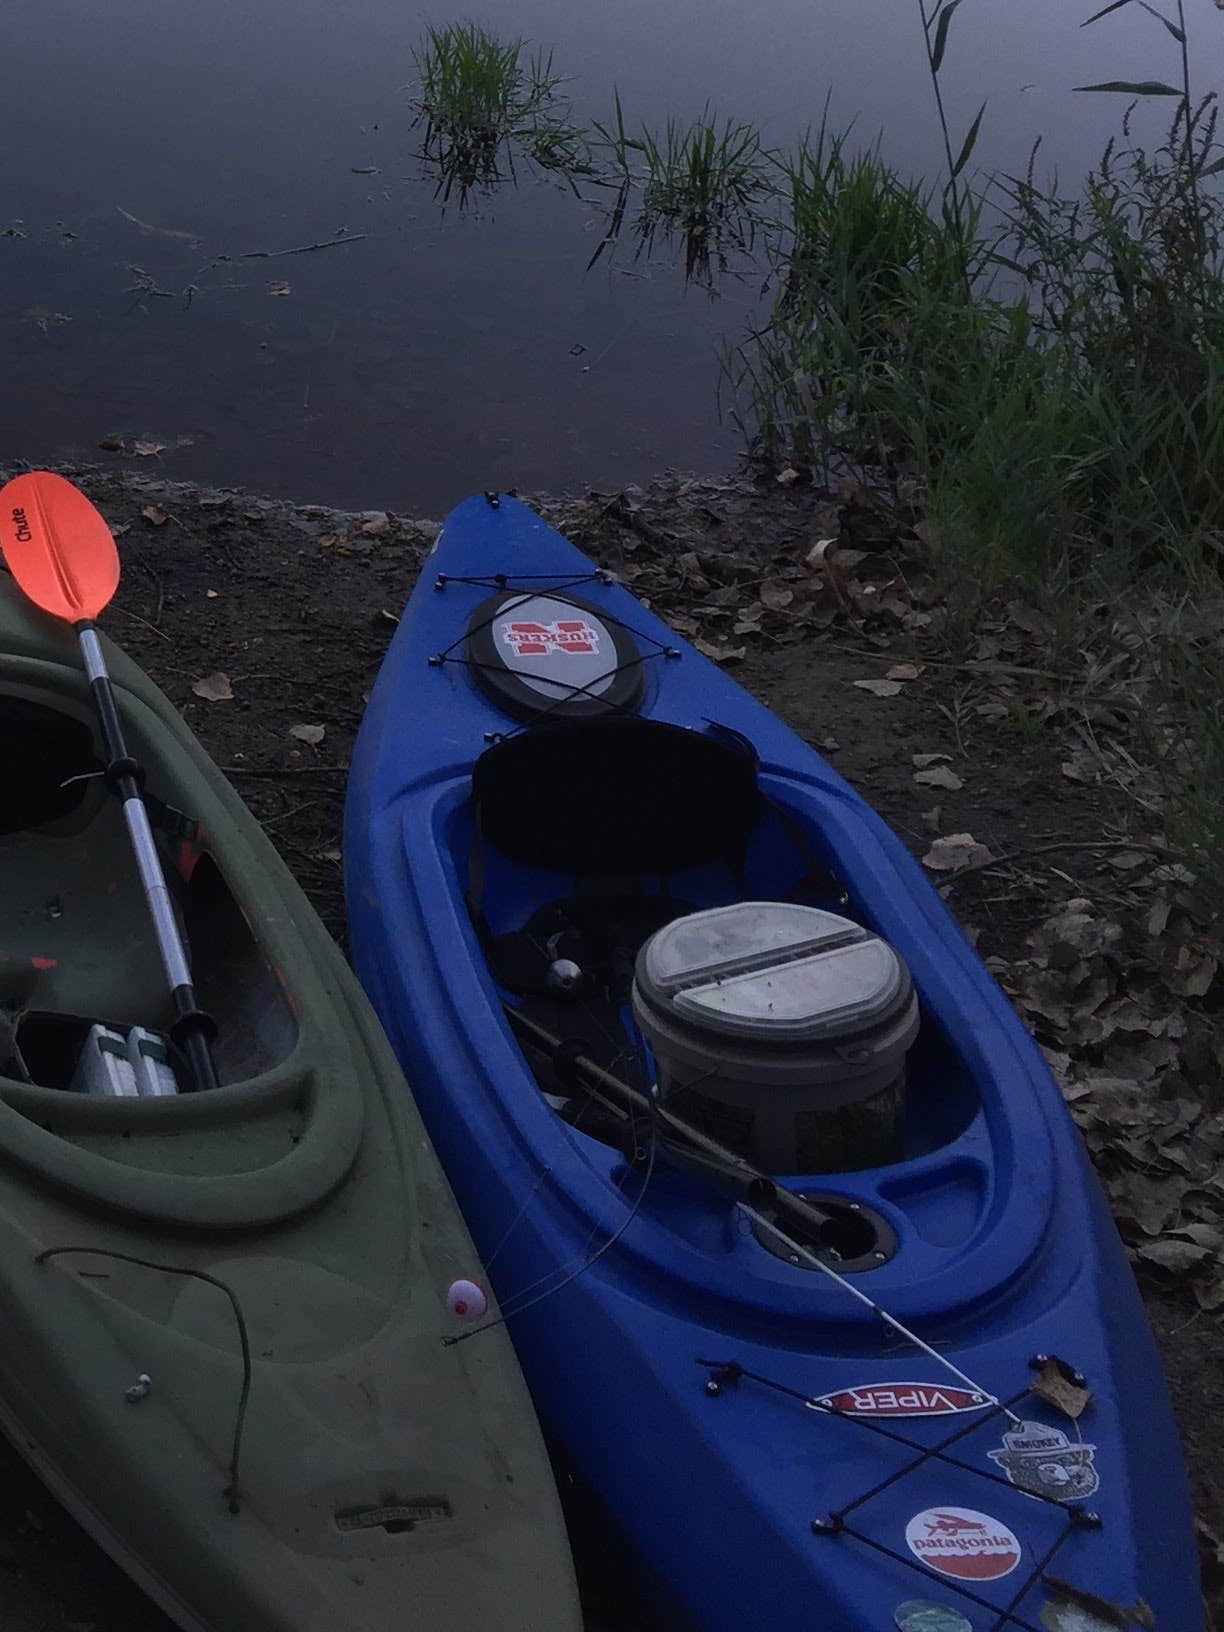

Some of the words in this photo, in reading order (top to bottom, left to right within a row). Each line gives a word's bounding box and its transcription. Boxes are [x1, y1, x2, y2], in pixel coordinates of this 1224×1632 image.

[12, 508, 33, 542] Chute
[507, 631, 595, 642] HUSKERS
[849, 1390, 957, 1410] VIPER
[1012, 1437, 1060, 1449] SMOKEY
[912, 1535, 1012, 1550] patagonia
